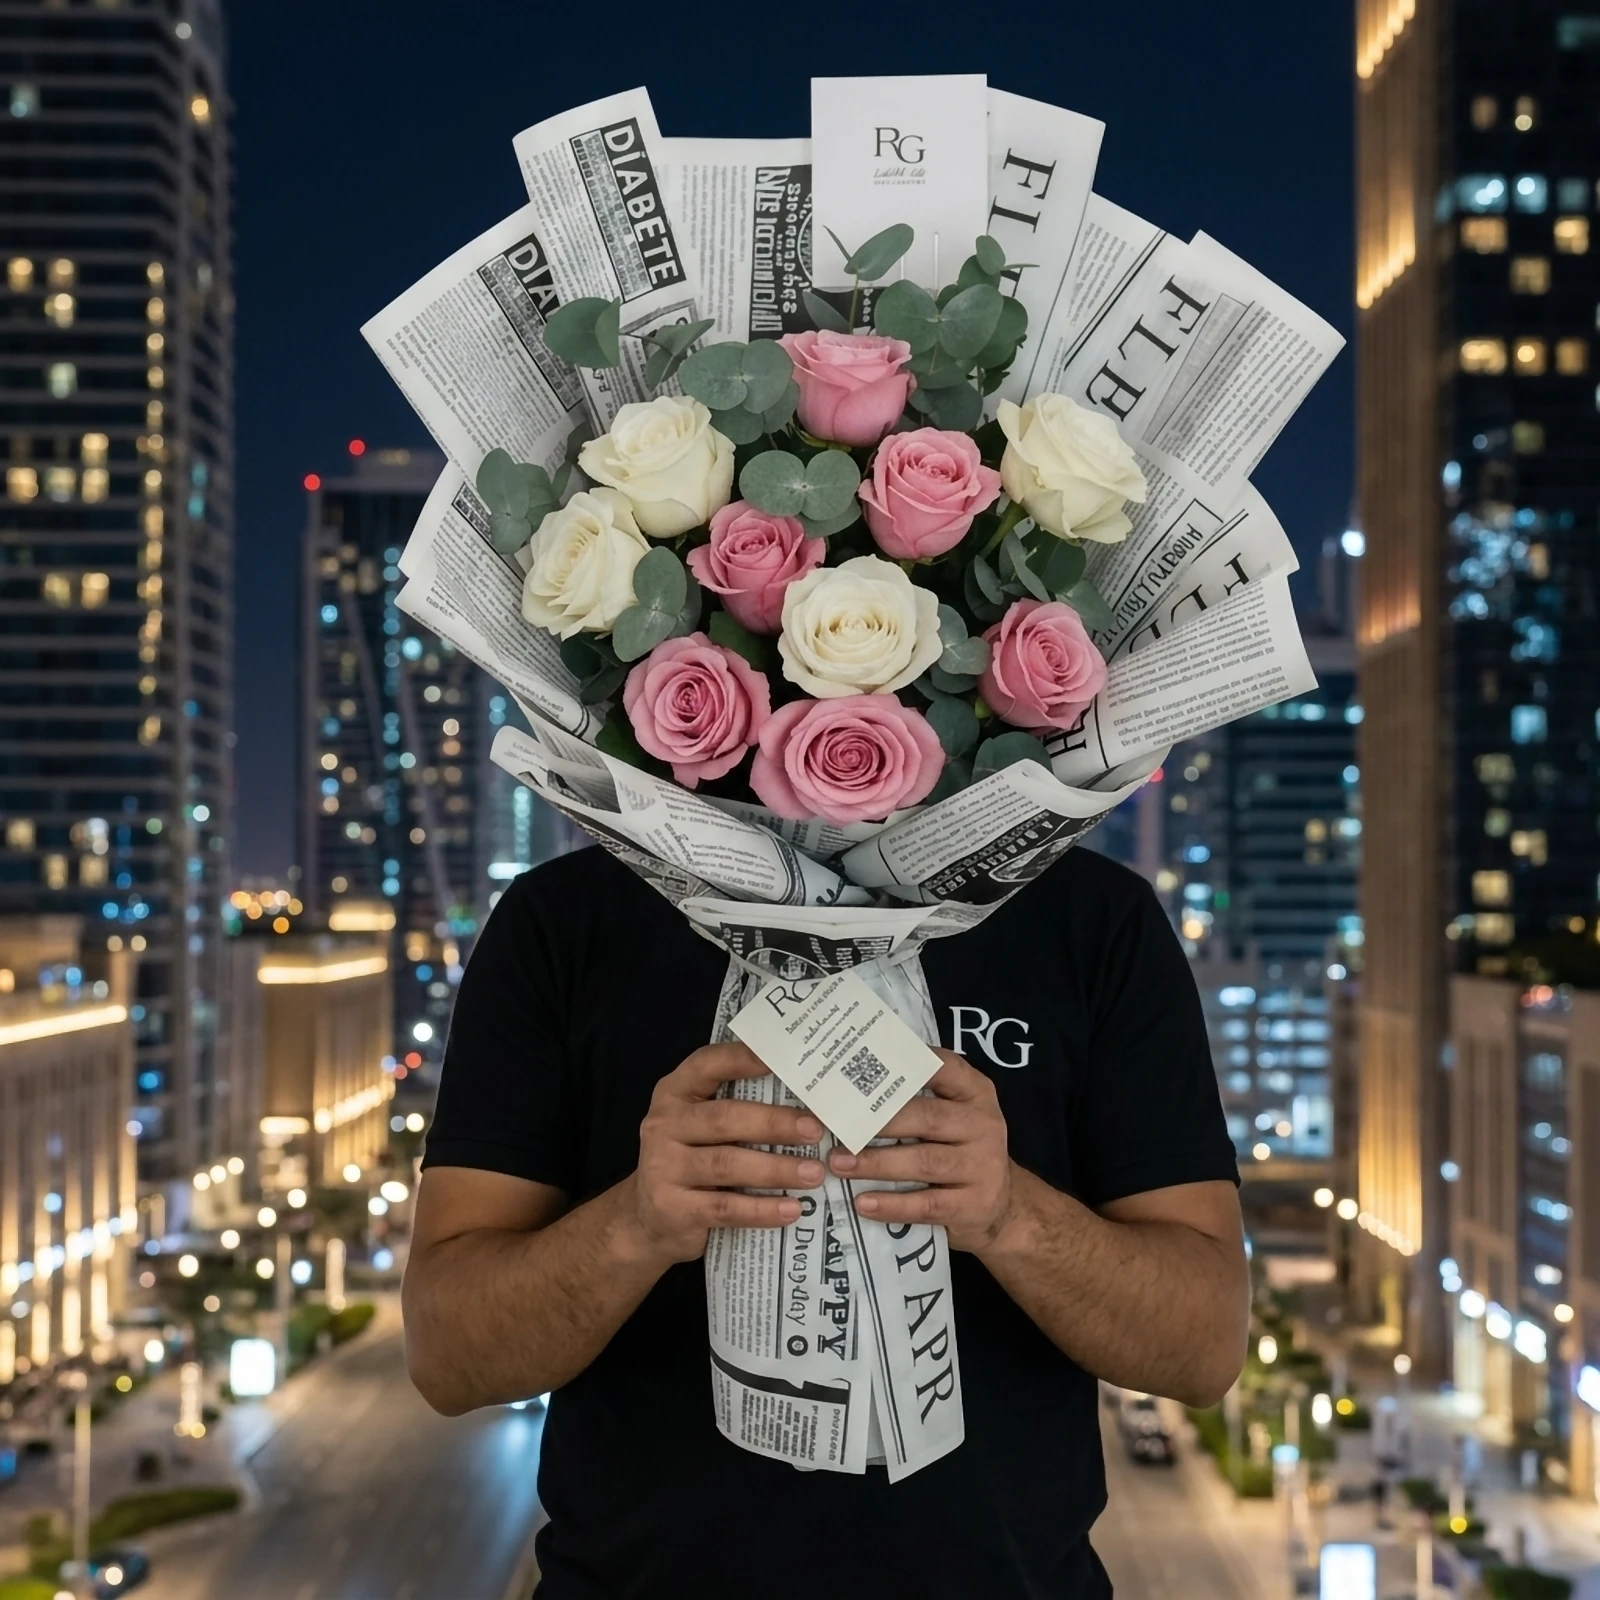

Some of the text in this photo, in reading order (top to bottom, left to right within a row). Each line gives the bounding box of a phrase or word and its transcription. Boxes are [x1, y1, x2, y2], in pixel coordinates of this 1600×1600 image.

[874, 127, 926, 164] RG
[507, 241, 560, 318] DIA
[949, 1006, 1034, 1069] RG
